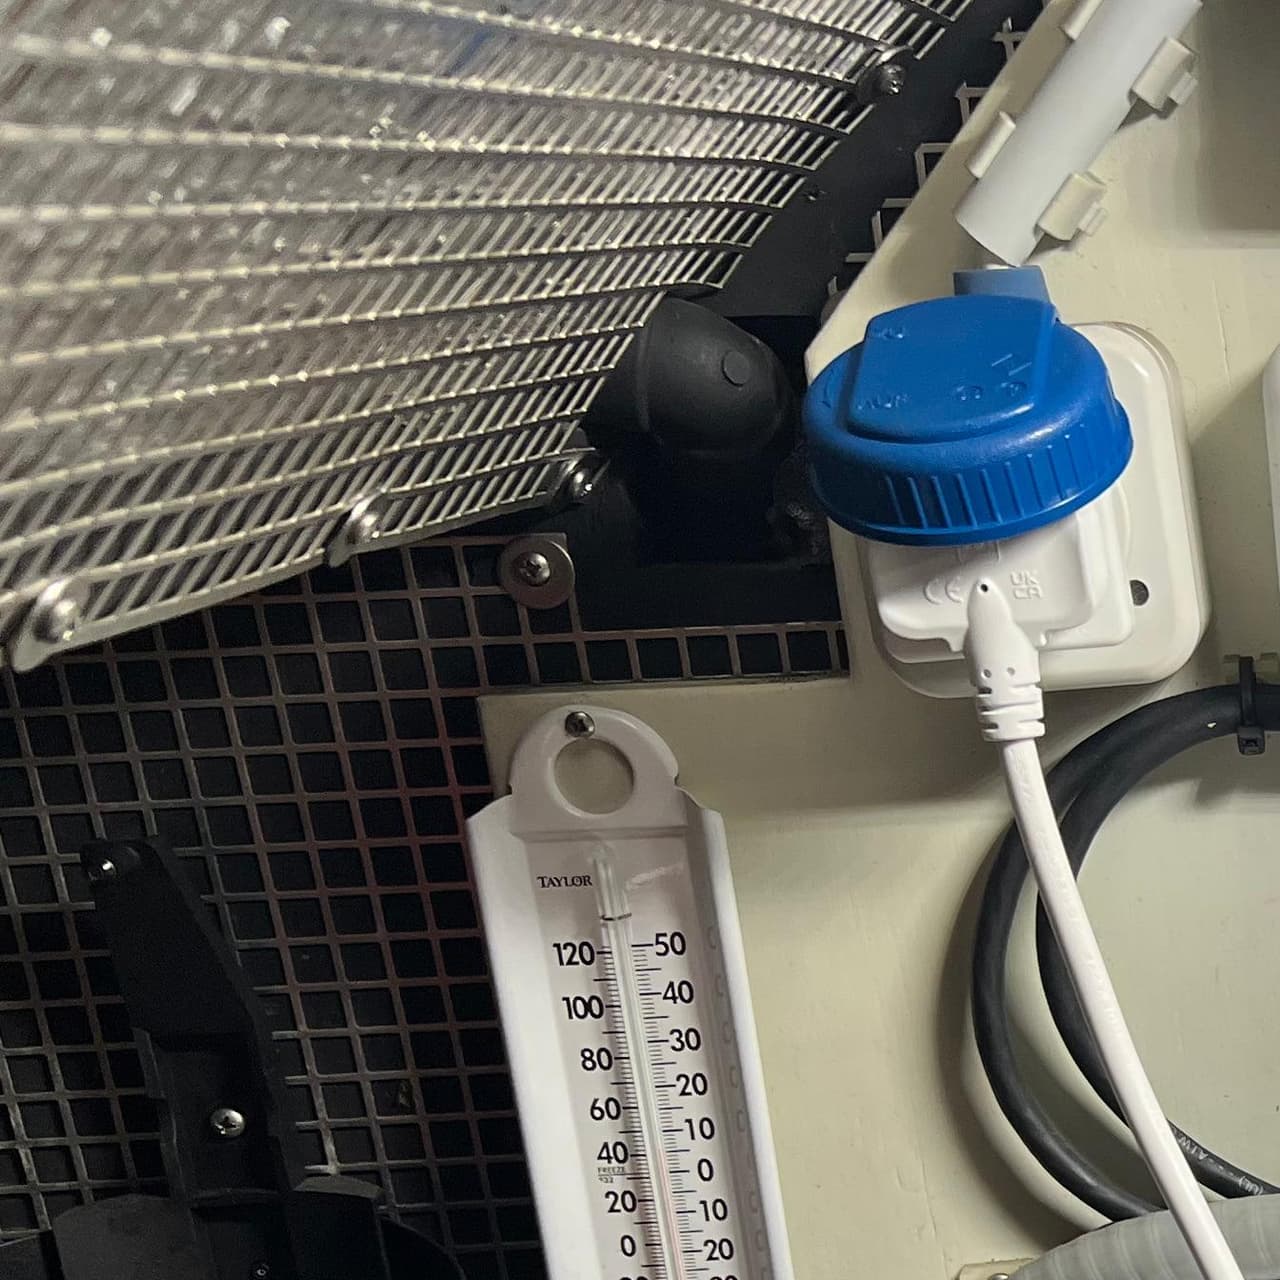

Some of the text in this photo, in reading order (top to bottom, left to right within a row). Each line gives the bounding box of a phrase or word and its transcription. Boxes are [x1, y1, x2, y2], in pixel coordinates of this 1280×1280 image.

[537, 875, 593, 889] TAYLOR
[552, 941, 595, 967] 120
[653, 931, 687, 957] 50
[662, 979, 695, 1005] 40
[562, 995, 605, 1021] 100
[669, 1028, 701, 1053] 30
[580, 1047, 614, 1072] 80
[675, 1073, 708, 1097] 20
[590, 1097, 622, 1121] 60
[684, 1116, 715, 1141] 10
[597, 1141, 629, 1165] 40
[697, 1158, 714, 1182] 0
[606, 1190, 637, 1214] 20
[699, 1198, 728, 1222] 10
[620, 1235, 636, 1258] 0
[703, 1237, 734, 1261] 20
